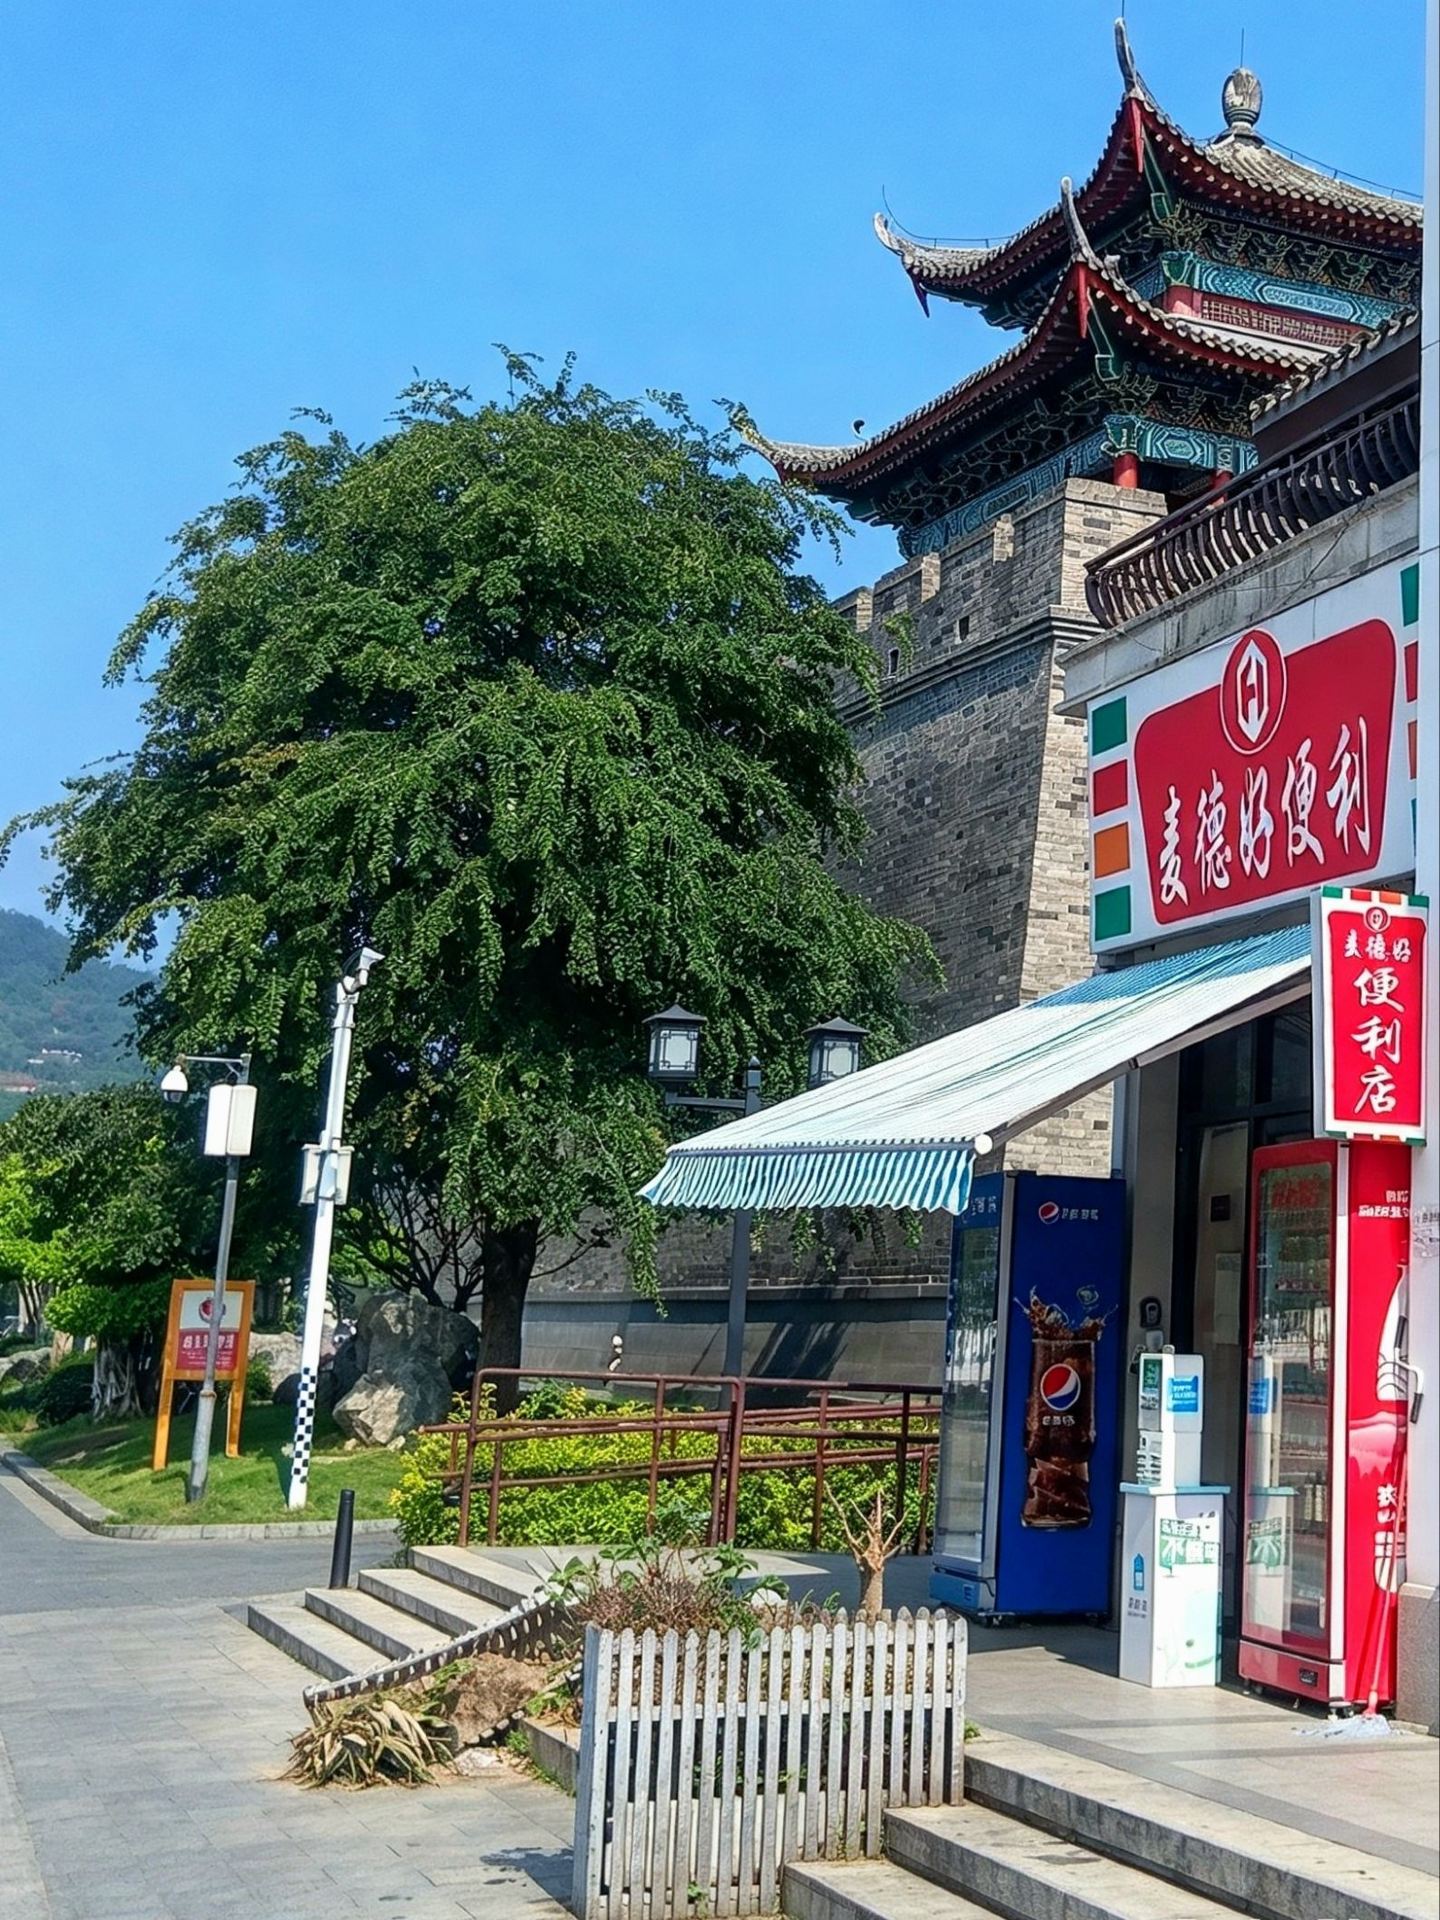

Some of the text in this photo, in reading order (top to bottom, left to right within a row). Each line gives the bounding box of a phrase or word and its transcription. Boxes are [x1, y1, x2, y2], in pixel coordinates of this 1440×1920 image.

[1159, 716, 1370, 906] 麦德好便利
[1351, 966, 1405, 1115] 便利店
